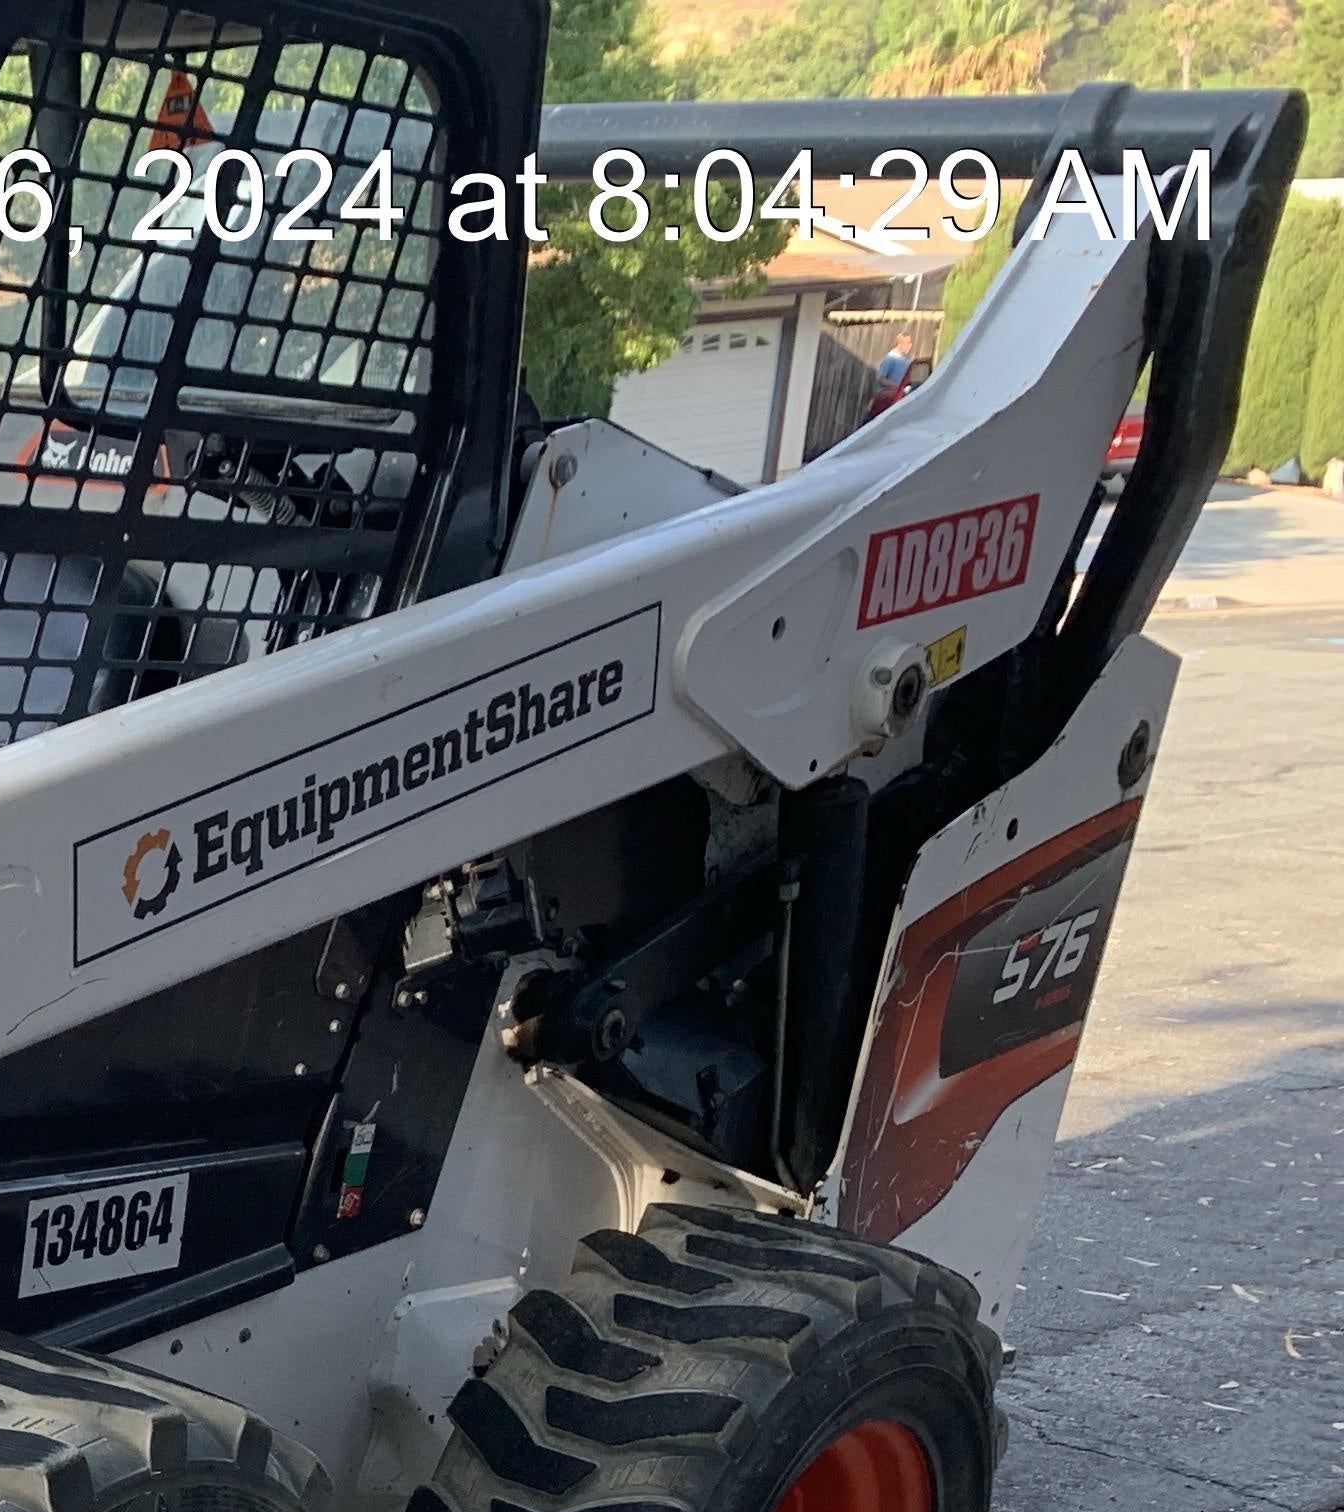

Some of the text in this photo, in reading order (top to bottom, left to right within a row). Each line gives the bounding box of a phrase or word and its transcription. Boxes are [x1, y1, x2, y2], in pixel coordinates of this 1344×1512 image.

[866, 502, 1029, 620] AD8P36
[192, 658, 624, 884] EquipmentShare
[992, 908, 1100, 1006] S76
[29, 1185, 176, 1270] 134864
